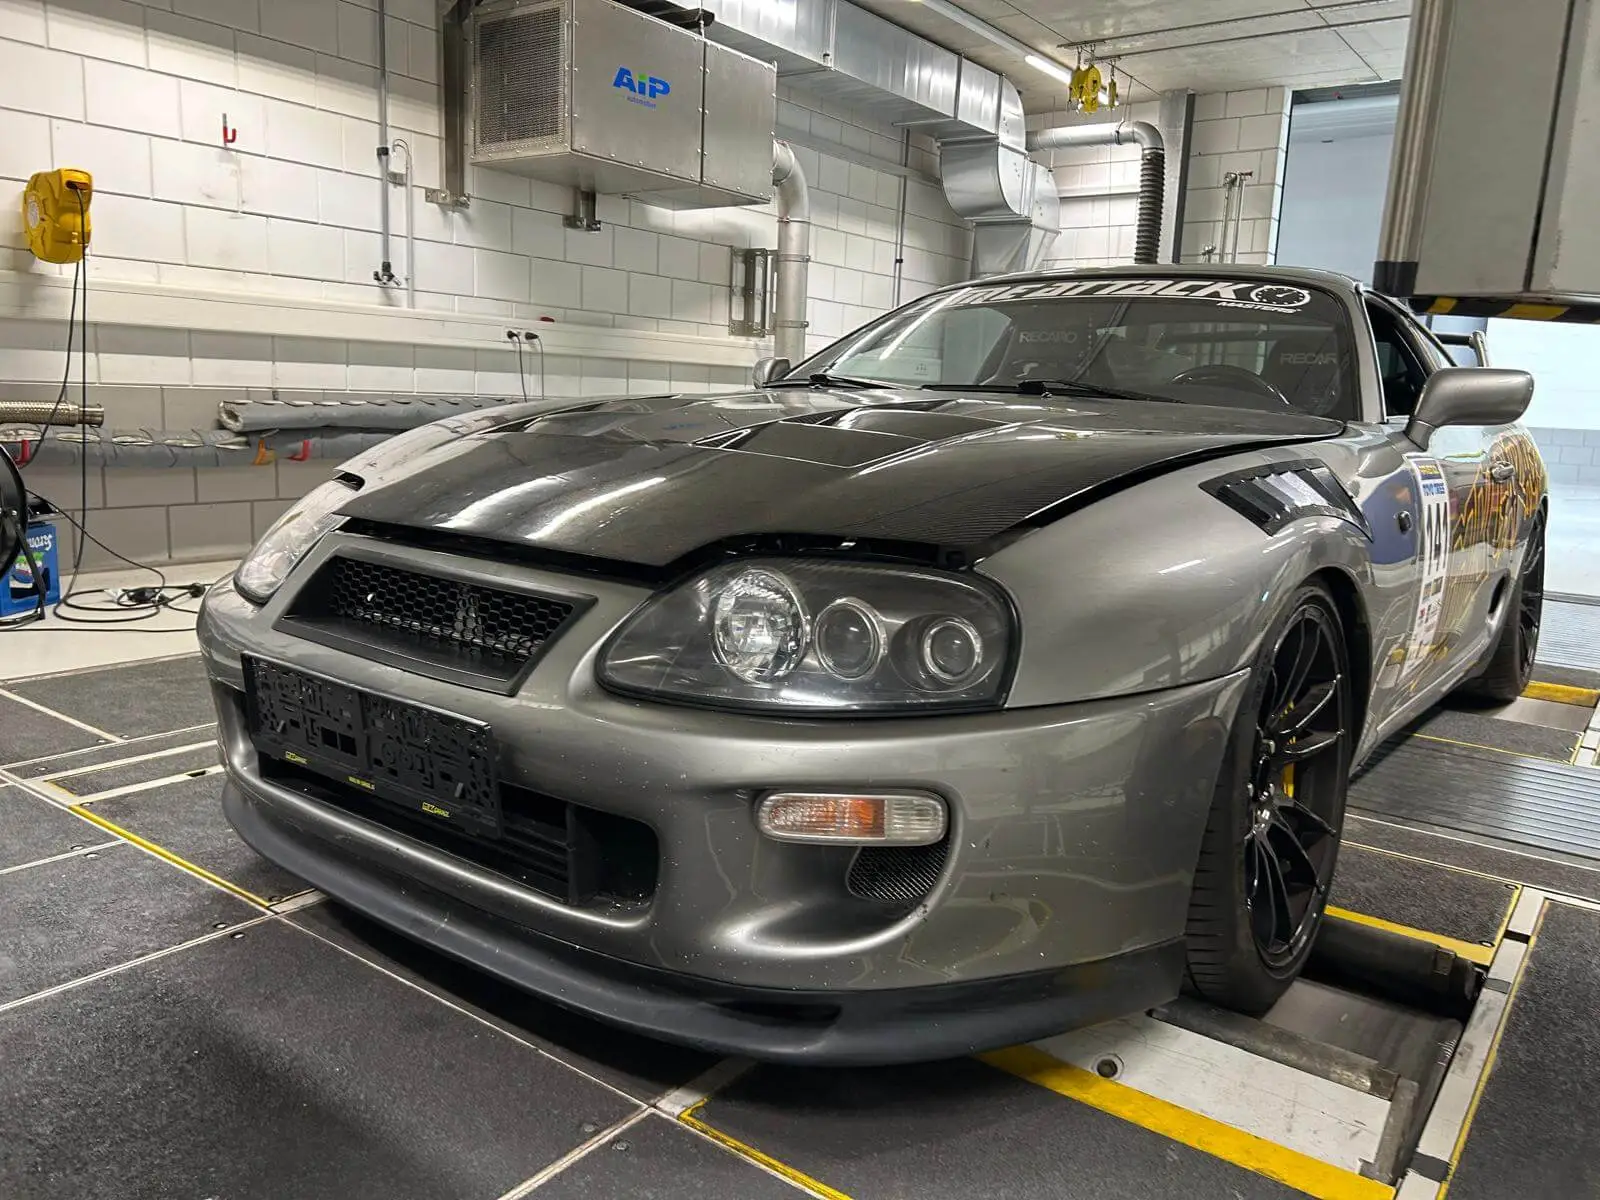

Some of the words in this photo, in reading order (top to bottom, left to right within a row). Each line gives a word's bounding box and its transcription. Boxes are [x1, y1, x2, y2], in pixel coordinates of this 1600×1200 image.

[1217, 301, 1298, 314] MASTERS
[1018, 330, 1078, 344] RECARO
[1279, 352, 1338, 366] RECAR
